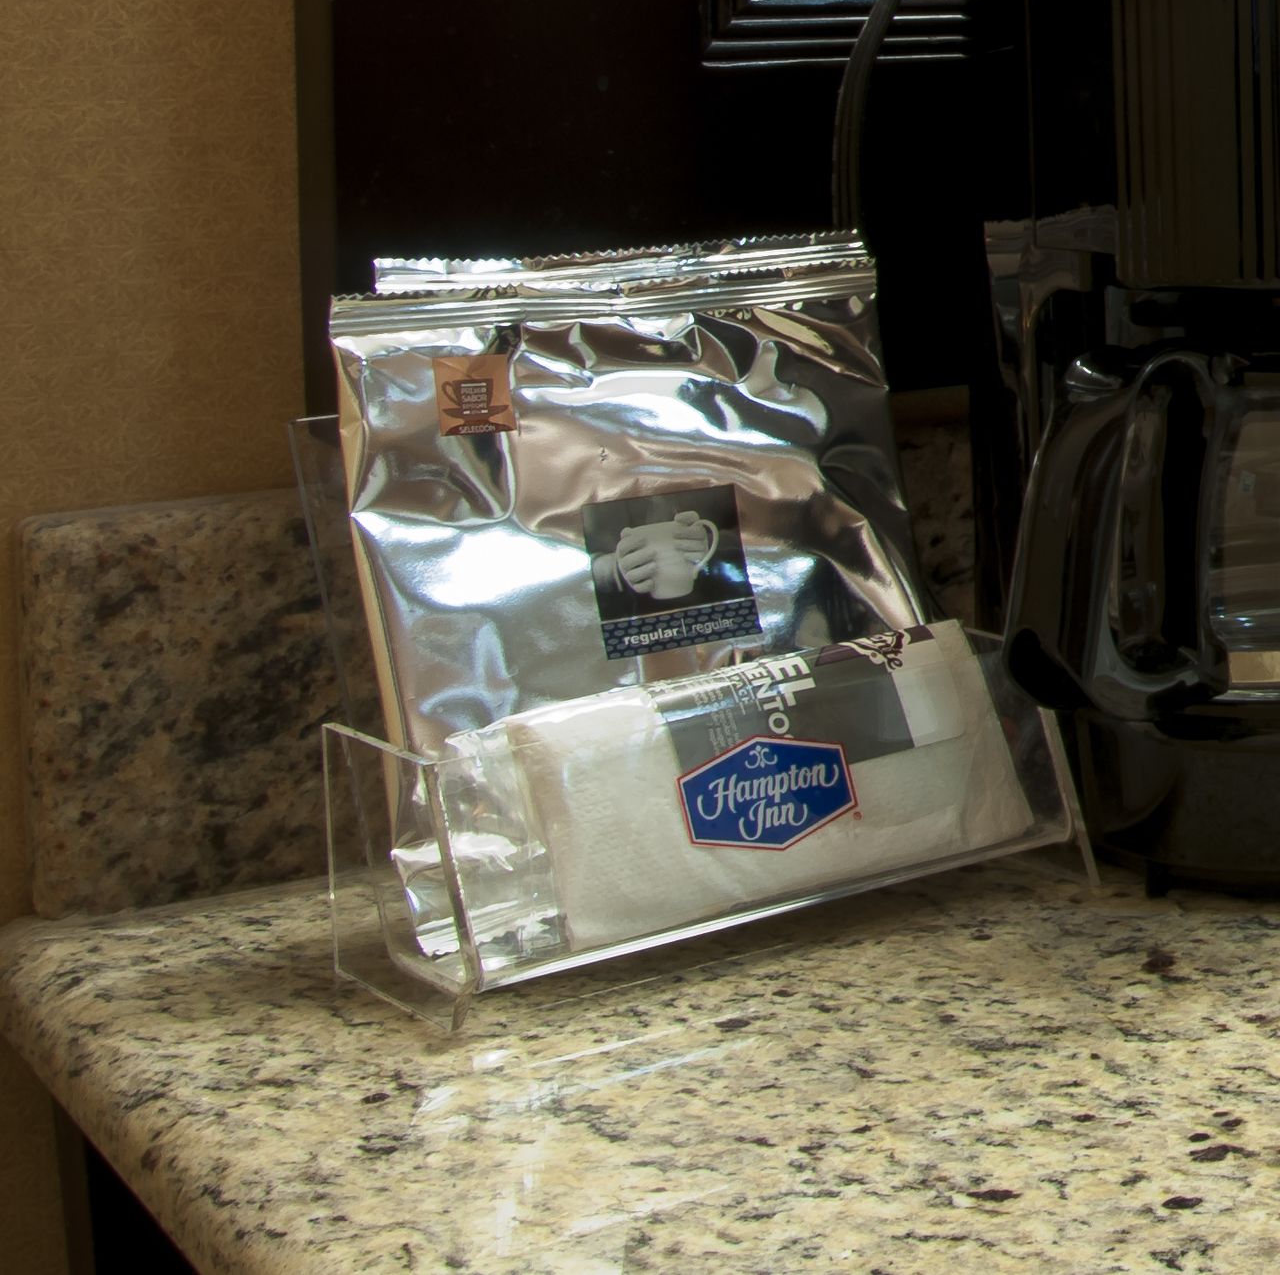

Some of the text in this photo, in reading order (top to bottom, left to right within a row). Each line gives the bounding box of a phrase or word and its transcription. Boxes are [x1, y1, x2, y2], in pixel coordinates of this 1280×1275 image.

[624, 626, 679, 645] regular
[692, 617, 735, 634] regular
[697, 763, 839, 821] Hampton
[739, 799, 808, 840] Inn
